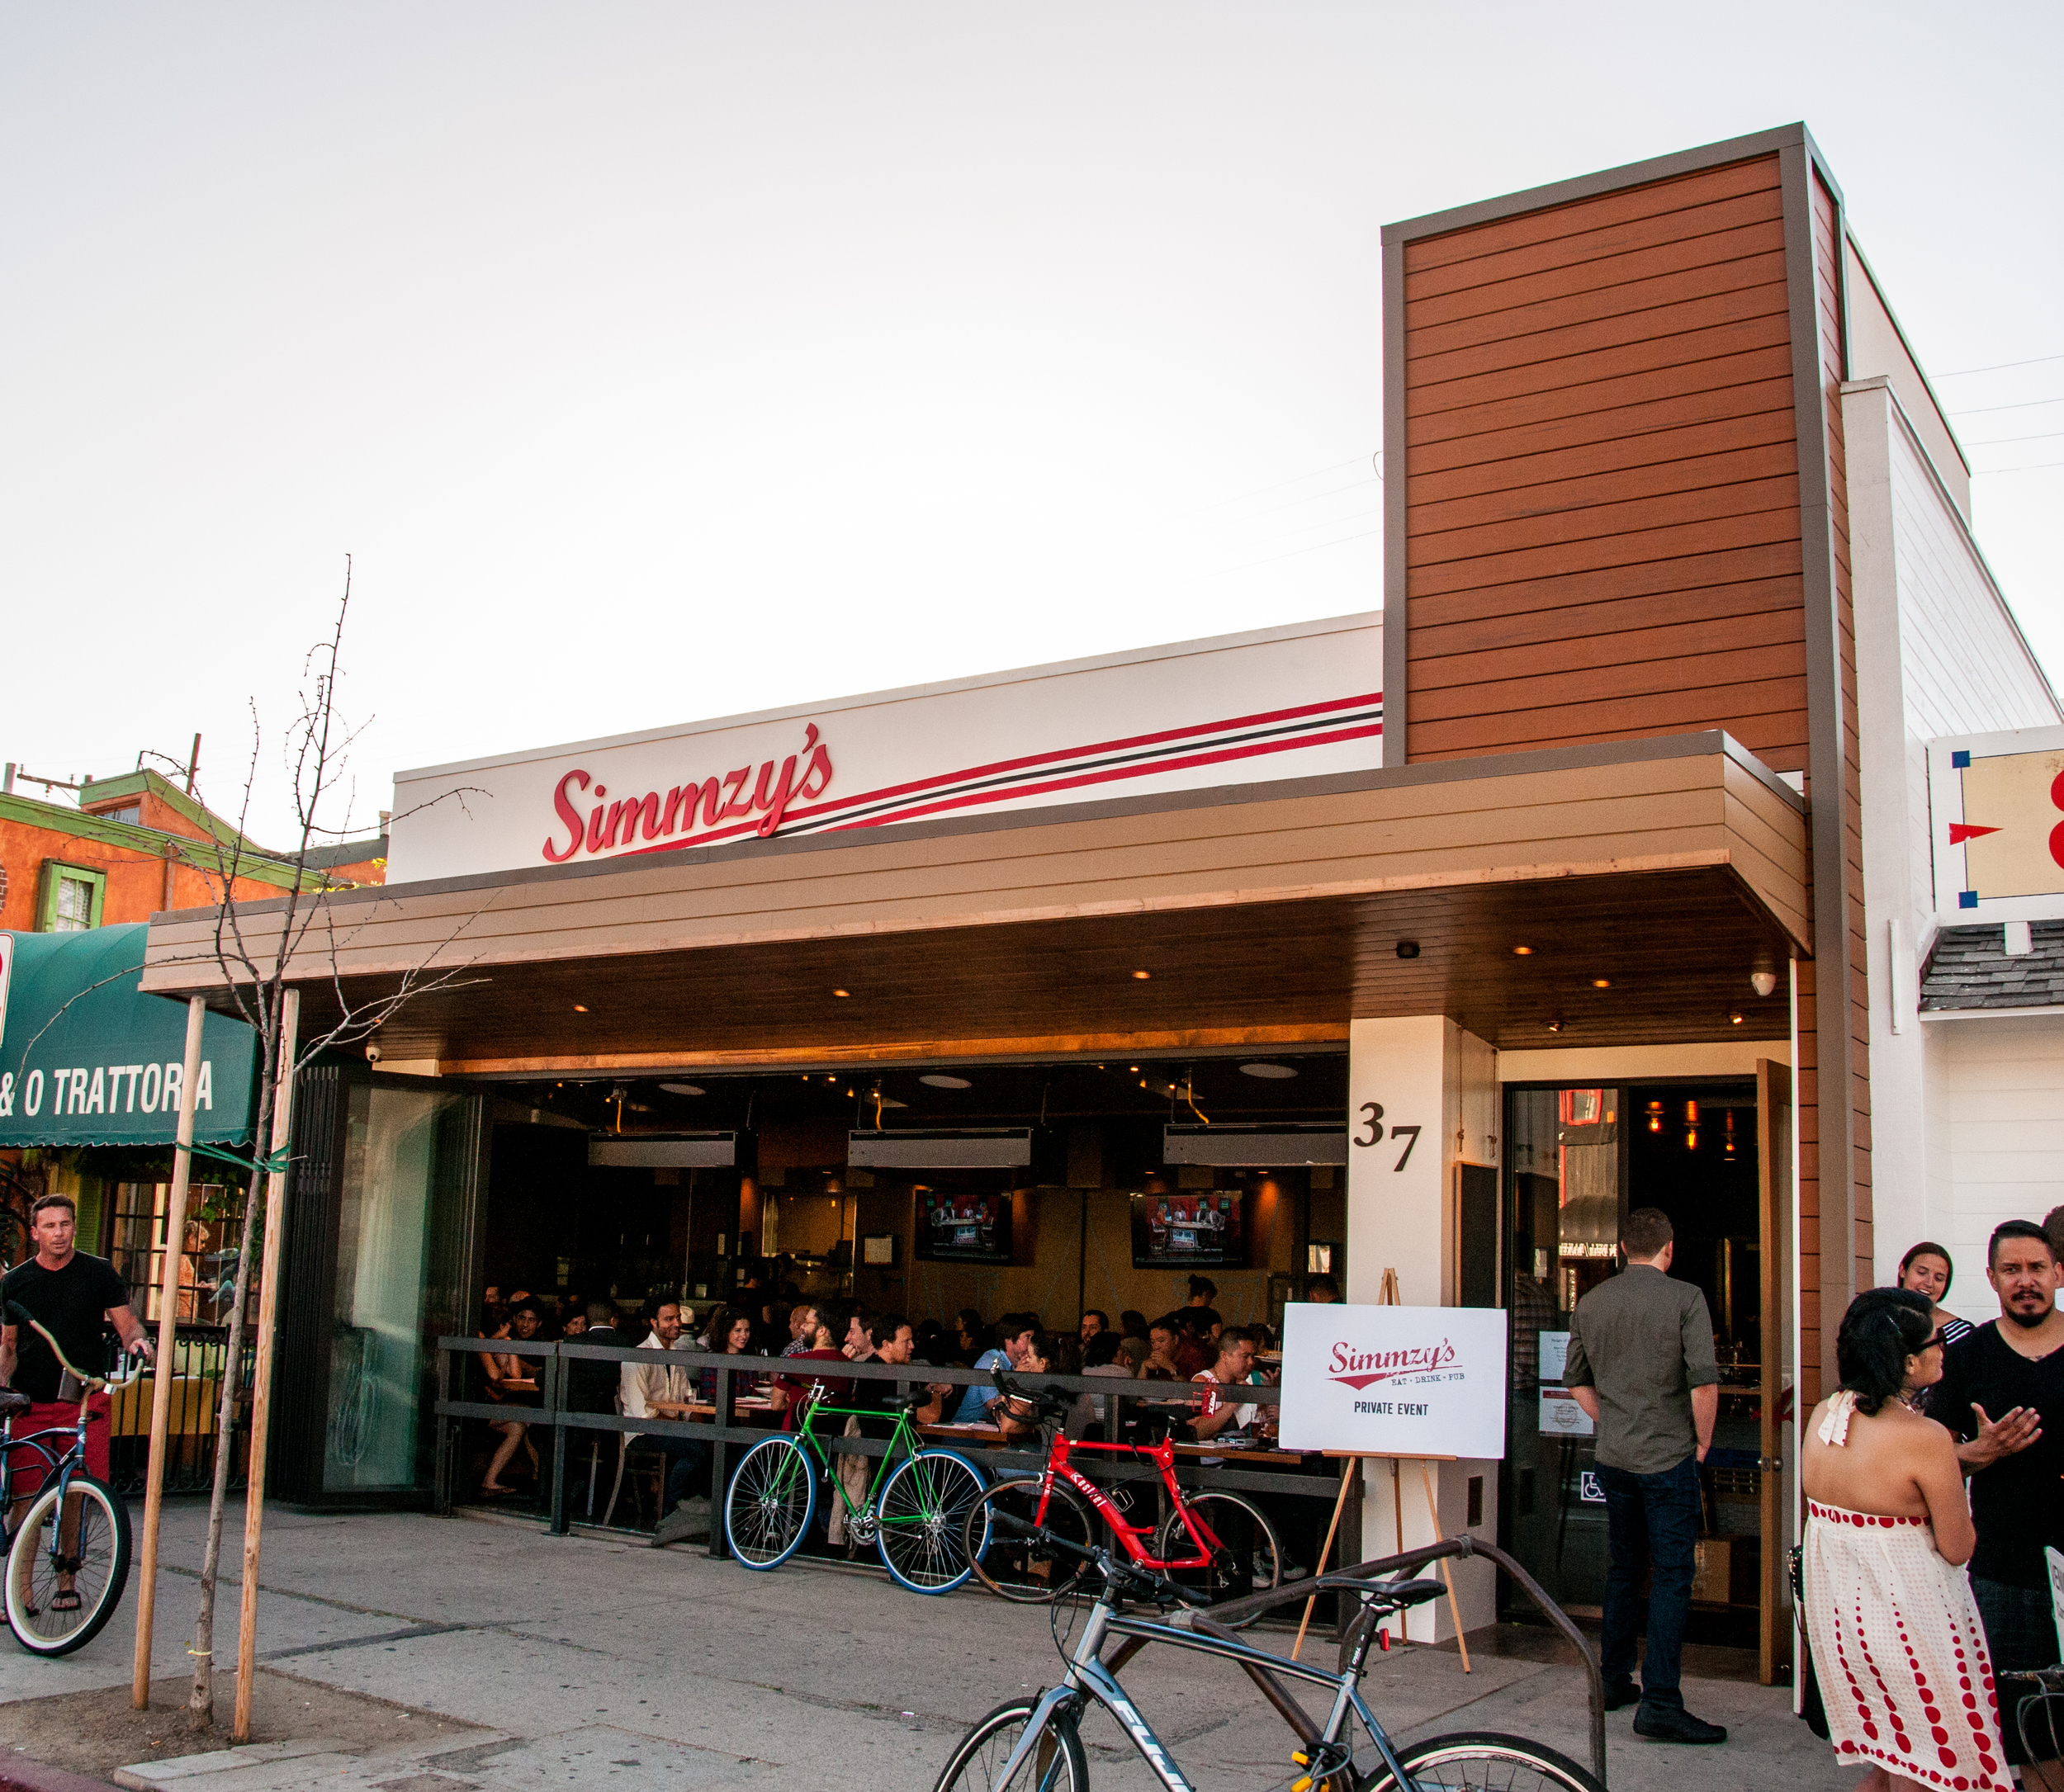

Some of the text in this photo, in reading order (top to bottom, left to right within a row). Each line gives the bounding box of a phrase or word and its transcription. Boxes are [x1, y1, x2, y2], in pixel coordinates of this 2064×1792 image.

[542, 730, 832, 863] Simmzy's
[24, 1069, 45, 1116] O
[53, 1060, 213, 1115] TRATTORA
[1353, 1101, 1422, 1172] 37
[1328, 1336, 1456, 1373] Simmzy's
[1391, 1373, 1465, 1387] EAT DRINK PUB
[1354, 1401, 1429, 1416] PRIVATE EVENT
[1071, 1471, 1108, 1509] Kestrel
